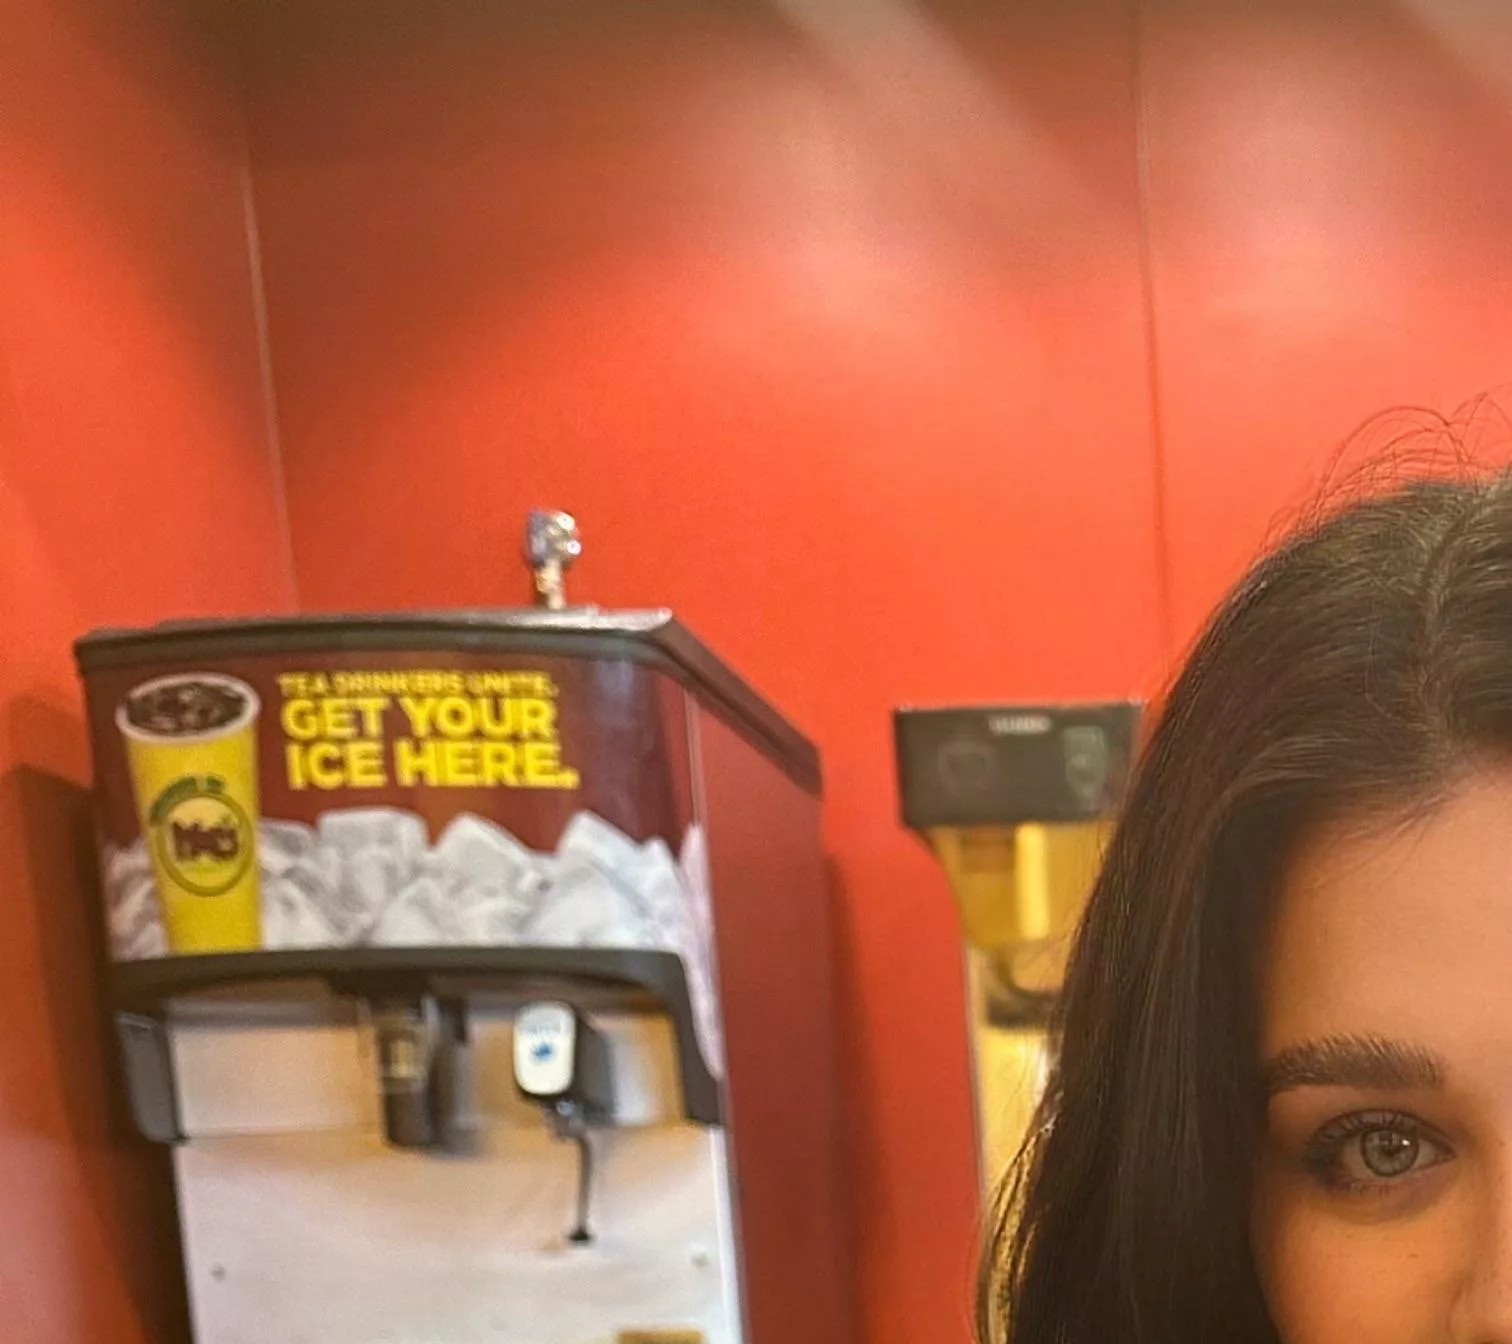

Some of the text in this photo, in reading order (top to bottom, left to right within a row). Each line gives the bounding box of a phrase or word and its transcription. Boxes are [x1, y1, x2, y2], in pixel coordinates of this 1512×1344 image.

[280, 697, 557, 740] GET YOUR
[285, 737, 582, 790] ICE HERE.
